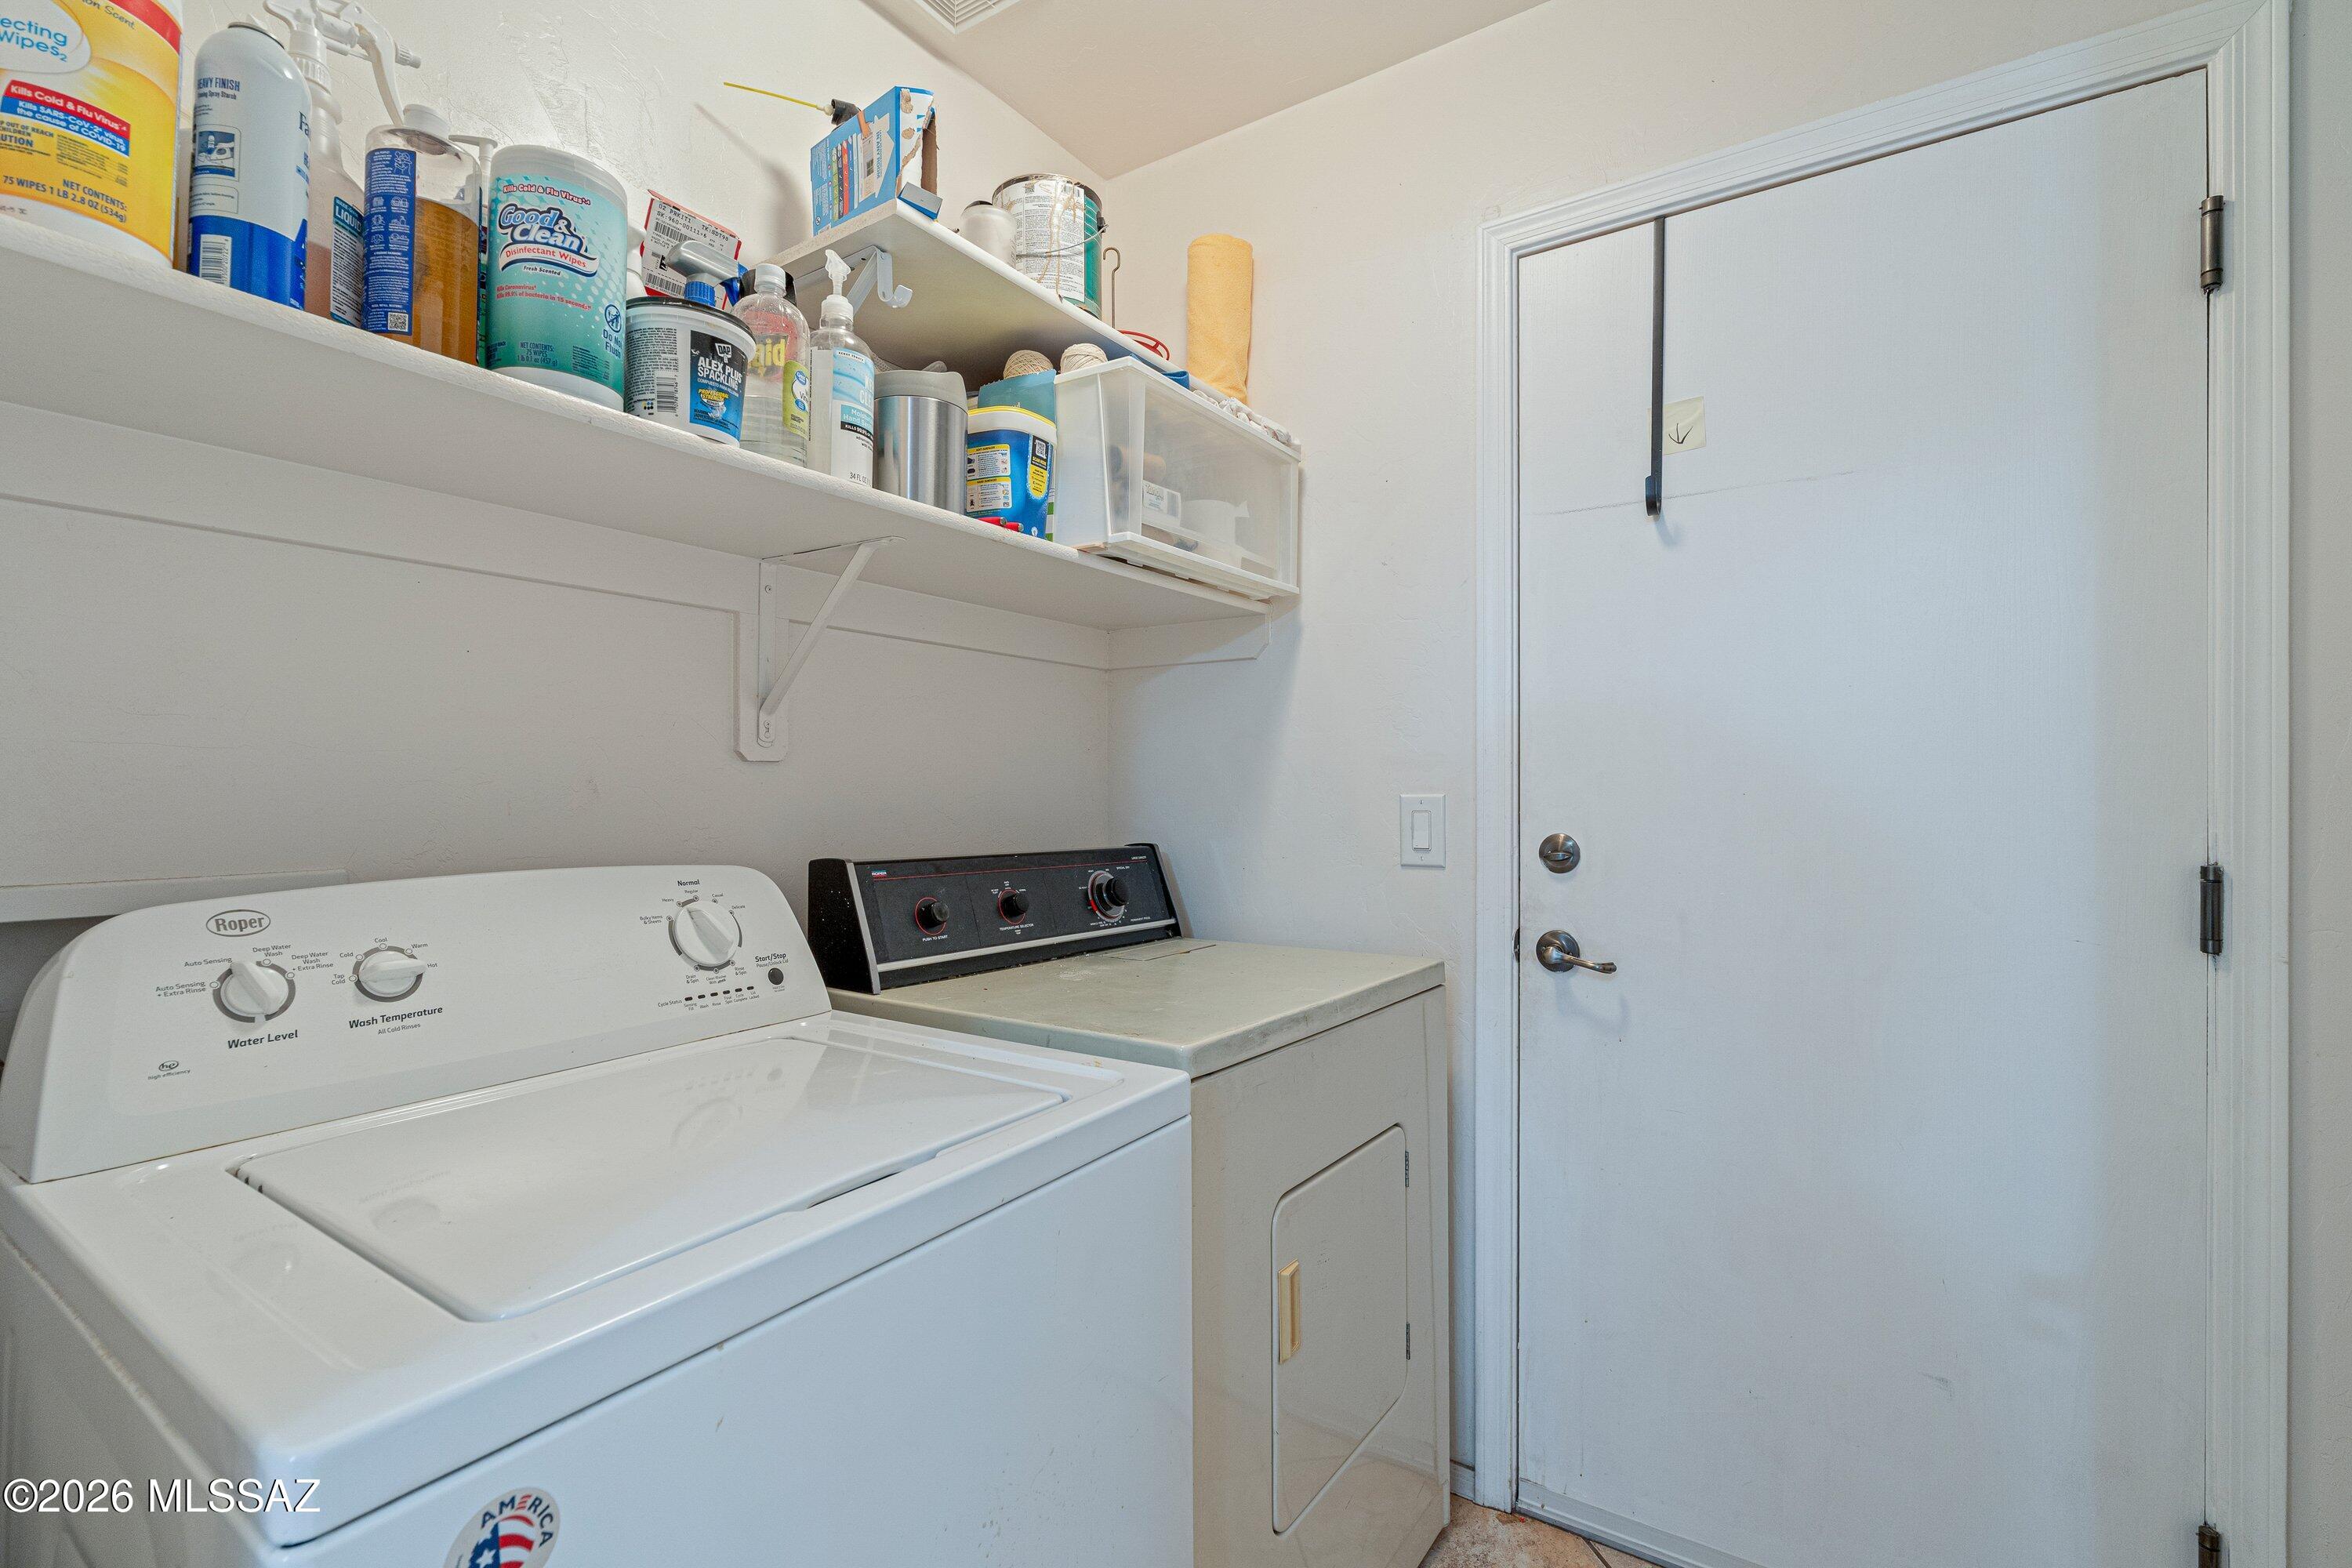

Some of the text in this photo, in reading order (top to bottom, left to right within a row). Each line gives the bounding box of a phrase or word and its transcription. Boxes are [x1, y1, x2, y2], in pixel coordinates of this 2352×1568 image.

[104, 5, 136, 30] Scent
[215, 77, 240, 92] FINISH
[11, 85, 93, 118] Kills Cold & Flu
[18, 100, 38, 111] Kills
[16, 107, 126, 151] the cause of COVID-19
[3, 175, 14, 184] 75
[16, 177, 46, 193] WIPES
[49, 187, 54, 195] 1
[57, 189, 69, 199] LB
[71, 194, 85, 205] 2.8
[88, 199, 99, 210] OZ
[63, 179, 127, 211] NET CONTENTS:
[503, 184, 517, 194] Kills
[518, 184, 535, 194] Cold
[546, 187, 560, 197] Flu
[500, 205, 575, 234] Good &
[512, 223, 581, 252] Clean
[505, 246, 587, 268] Disinfectant Wipes
[539, 267, 561, 276] Scented
[604, 328, 612, 341] Do
[605, 341, 621, 359] Flush
[717, 344, 732, 356] DAP
[697, 366, 739, 391] SPACKLING
[698, 356, 742, 383] ALEX PLUS
[857, 474, 862, 482] FL
[215, 916, 265, 934] Roper
[754, 953, 786, 963] Start/Stop
[349, 1007, 443, 1029] Wash Temperature
[227, 1029, 299, 1050] Water Level
[162, 1069, 191, 1077] efficiency
[481, 1494, 554, 1548] AMERICA
